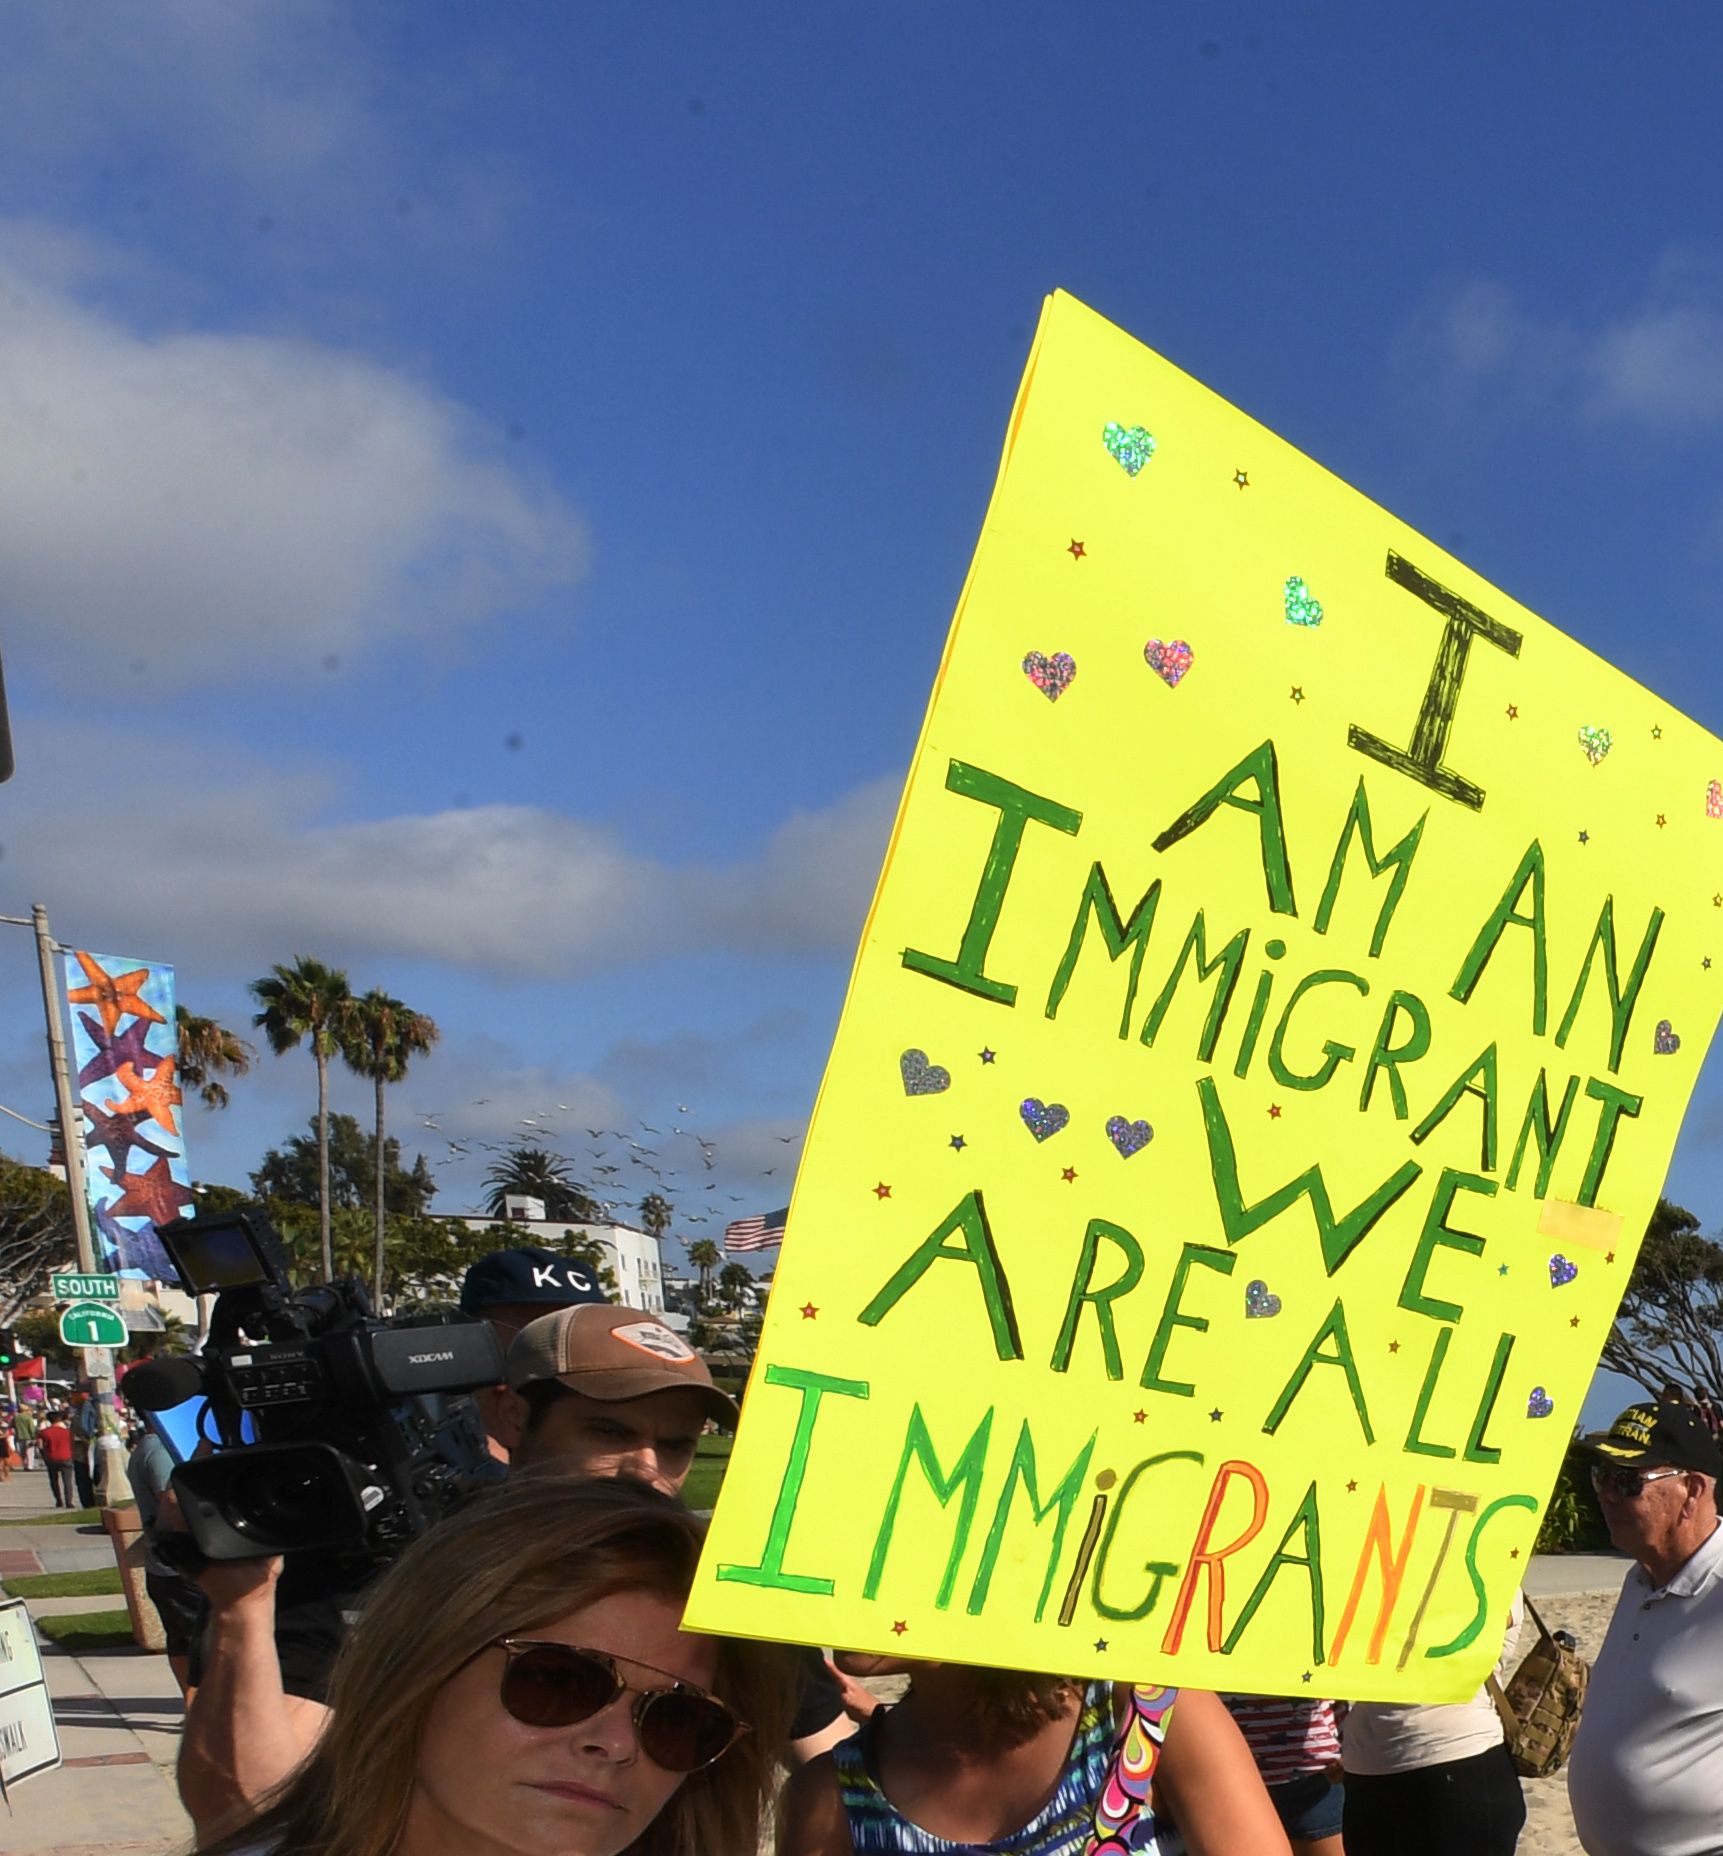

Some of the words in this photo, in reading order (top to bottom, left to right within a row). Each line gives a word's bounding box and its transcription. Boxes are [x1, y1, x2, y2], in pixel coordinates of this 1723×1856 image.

[1347, 548, 1523, 813] I
[1151, 739, 1430, 959] AM
[1447, 838, 1665, 1075] AN
[1195, 1076, 1499, 1324] WE
[57, 1279, 116, 1296] SOUTH
[68, 1309, 115, 1321] CALIFORNIA
[88, 1320, 99, 1342] 1
[857, 1189, 1238, 1397] ARE
[1261, 1296, 1516, 1464] ALL
[408, 1351, 453, 1364] XDCAM
